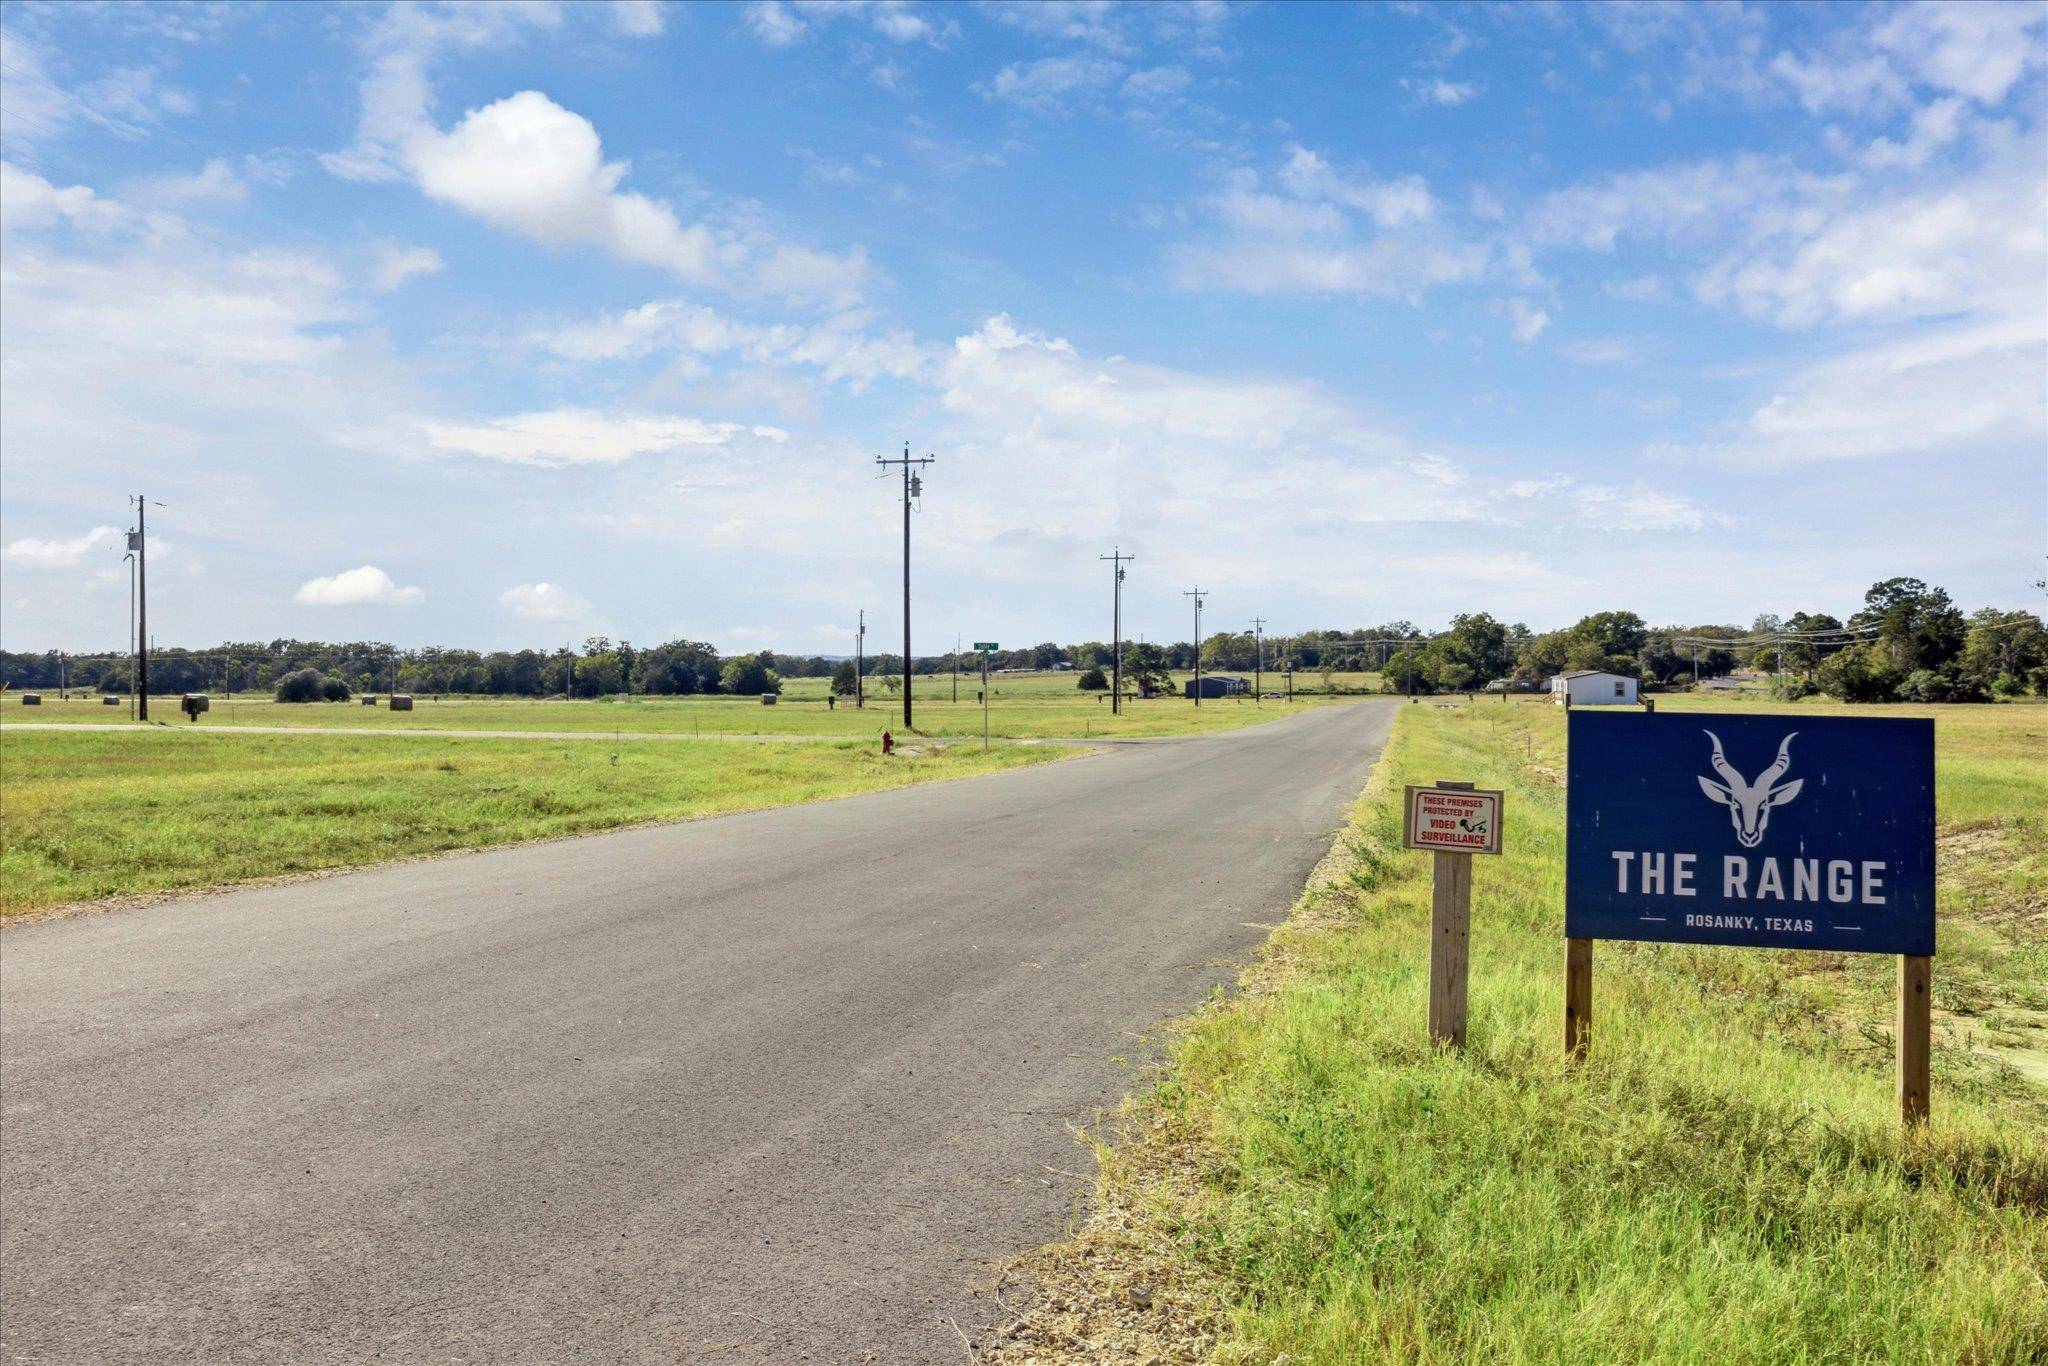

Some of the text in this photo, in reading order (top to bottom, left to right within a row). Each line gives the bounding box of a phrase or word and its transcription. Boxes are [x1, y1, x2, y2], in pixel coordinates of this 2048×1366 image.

[1424, 796, 1483, 807] THESE PREMISES
[1423, 806, 1474, 817] PROTECTED BY
[1430, 819, 1456, 829] VIDEO
[1421, 831, 1485, 844] SURVEILLANCE
[1612, 851, 1886, 905] THE RANGE
[1686, 914, 1813, 932] ROSANKY, TEXAS
